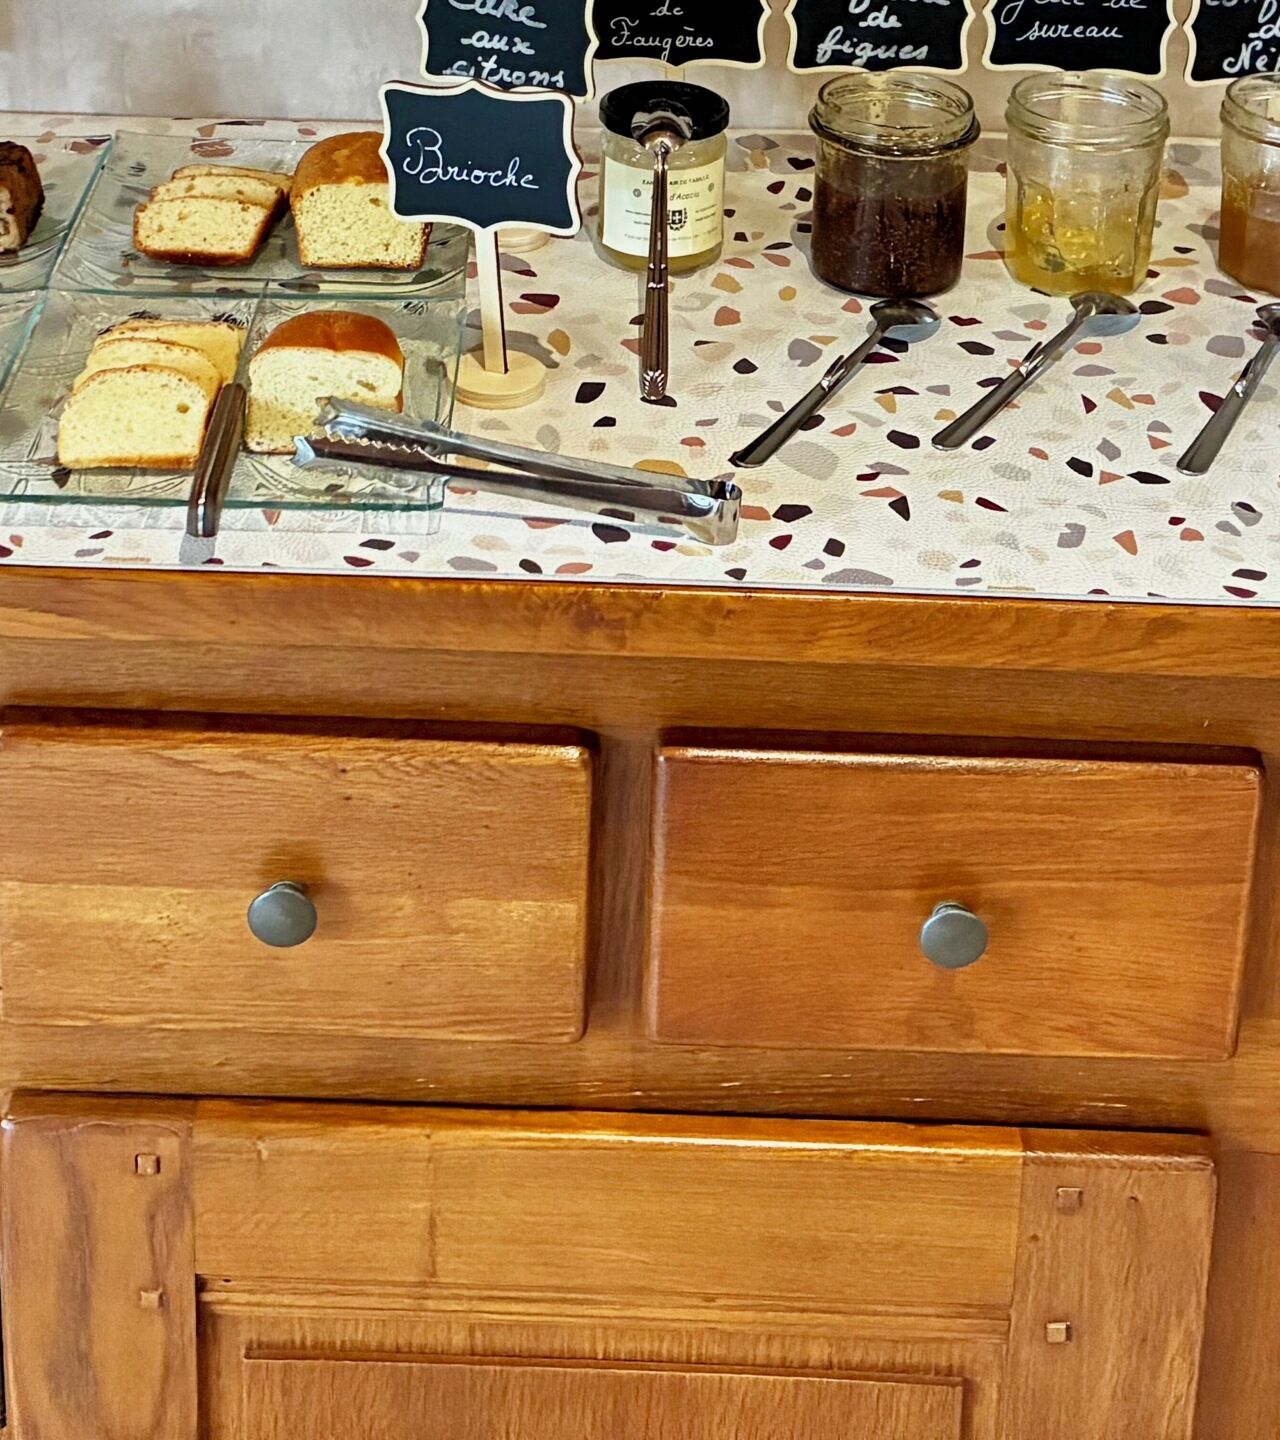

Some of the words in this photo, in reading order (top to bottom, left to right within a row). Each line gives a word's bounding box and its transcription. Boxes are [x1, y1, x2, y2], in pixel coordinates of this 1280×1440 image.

[858, 5, 902, 29] de
[1015, 20, 1124, 41] sureau
[460, 30, 536, 55] aux
[610, 16, 714, 62] Faugères
[815, 25, 929, 67] figues
[442, 54, 565, 89] citrons
[403, 126, 540, 190] Brioche
